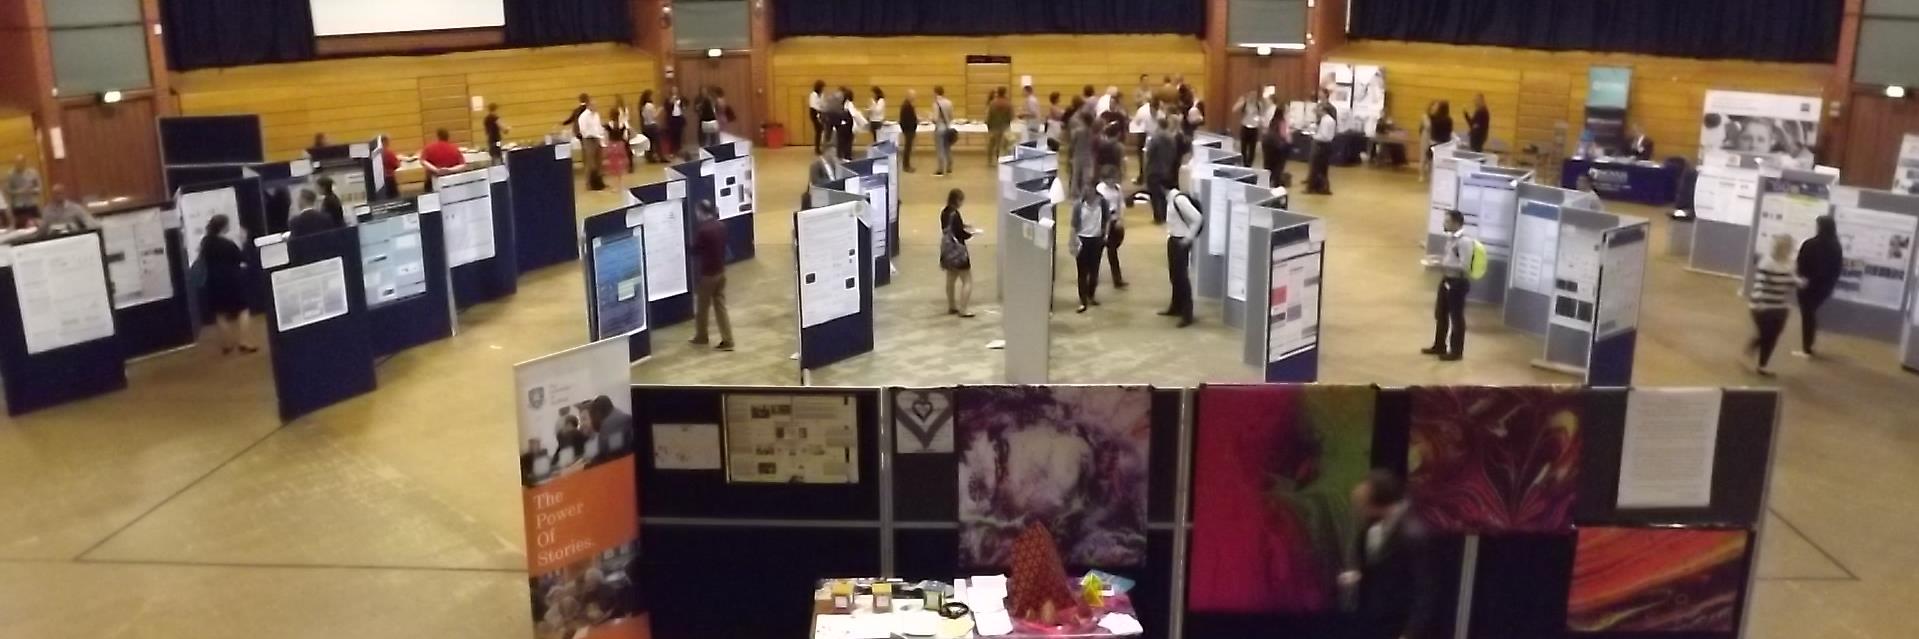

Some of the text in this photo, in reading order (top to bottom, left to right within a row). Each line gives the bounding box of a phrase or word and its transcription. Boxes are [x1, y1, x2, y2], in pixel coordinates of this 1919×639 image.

[533, 491, 564, 510] The
[536, 501, 585, 529] Power
[537, 528, 556, 548] Of
